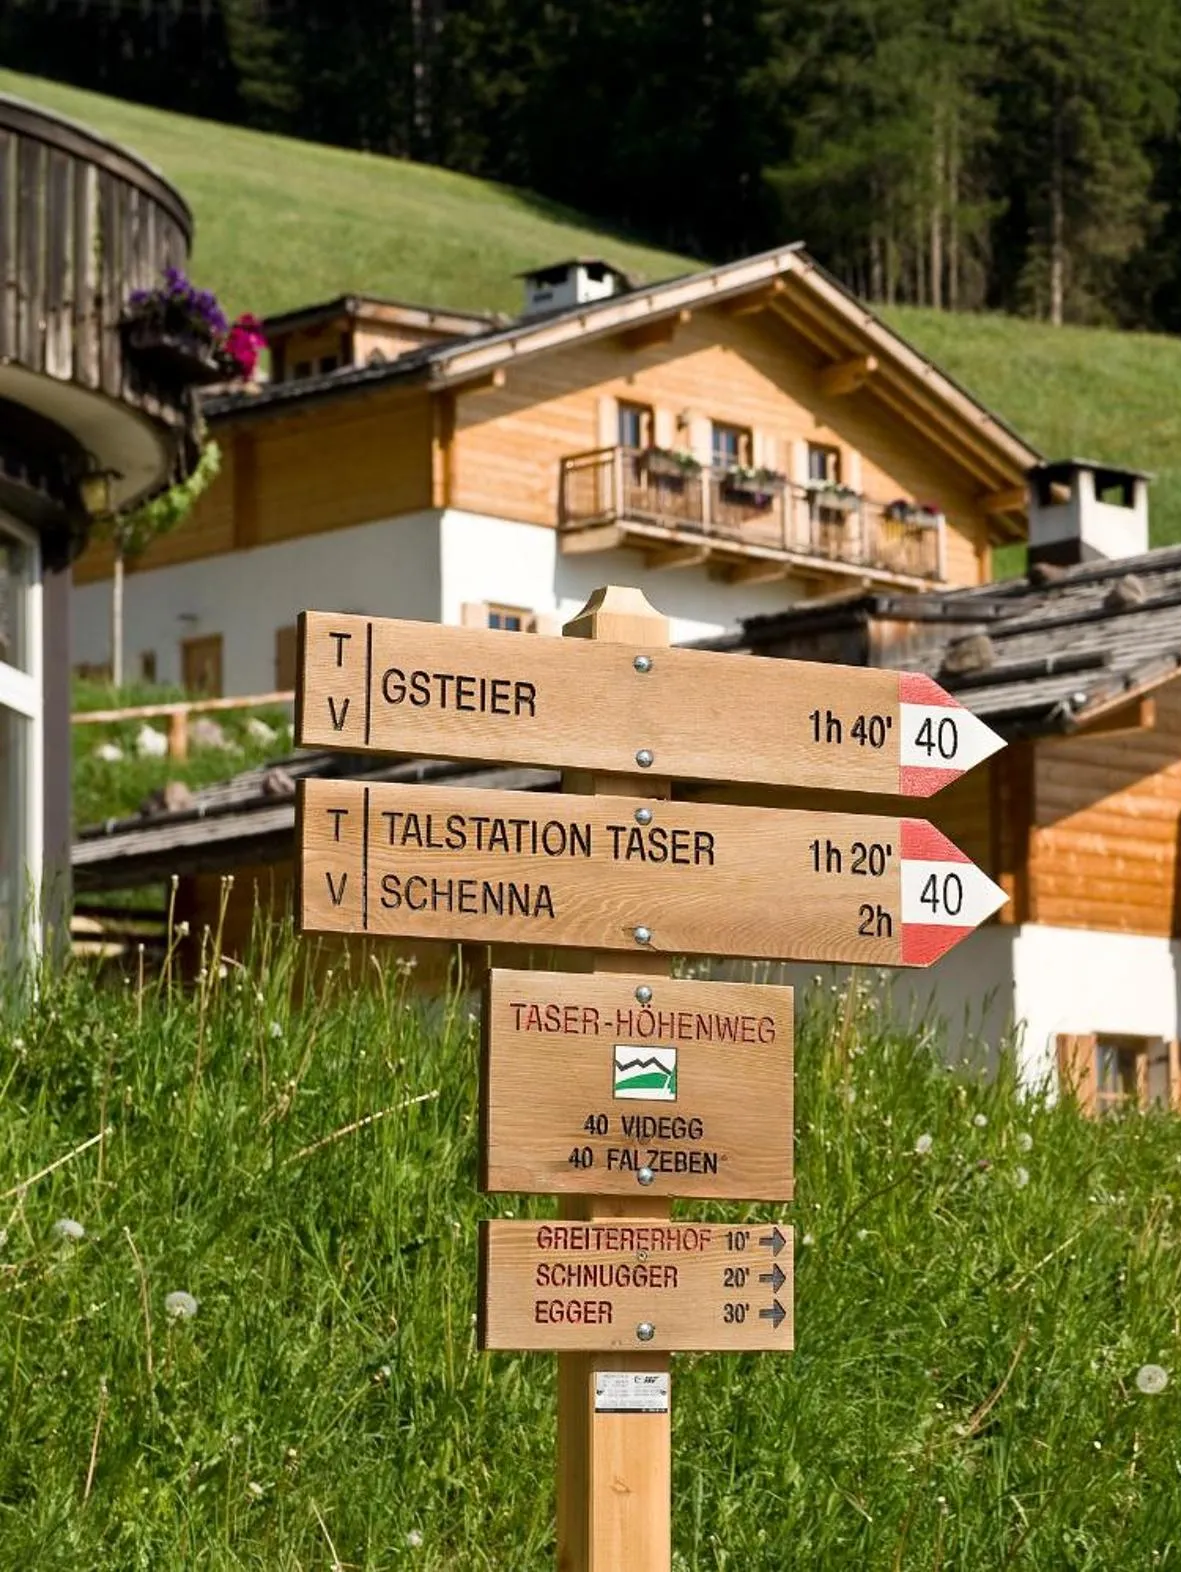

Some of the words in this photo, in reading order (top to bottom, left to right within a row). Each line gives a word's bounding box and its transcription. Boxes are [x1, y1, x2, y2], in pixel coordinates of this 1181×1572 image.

[328, 632, 352, 667] T
[382, 668, 537, 717] GSTEIER
[327, 696, 350, 731] V
[808, 709, 842, 744] 1h
[850, 714, 893, 750] 40'
[914, 717, 959, 760] 40
[326, 808, 349, 842] T
[382, 811, 592, 858] TALSTATION
[606, 825, 715, 866] TASER
[808, 839, 842, 874] 1h
[850, 842, 893, 878] 20'
[325, 872, 348, 906] V
[380, 873, 556, 919] SCHENNA
[919, 872, 964, 916] 40
[857, 903, 893, 938] 2h
[509, 1002, 776, 1044] TASER-HÖHENWEG
[583, 1113, 609, 1136] 40
[620, 1115, 704, 1140] VIDEGG
[568, 1146, 593, 1169] 40
[606, 1148, 718, 1174] FALZEBEN
[536, 1225, 712, 1252] GREITERERHOF
[536, 1263, 678, 1288] SCHNUGGER
[534, 1299, 613, 1324] EGGER
